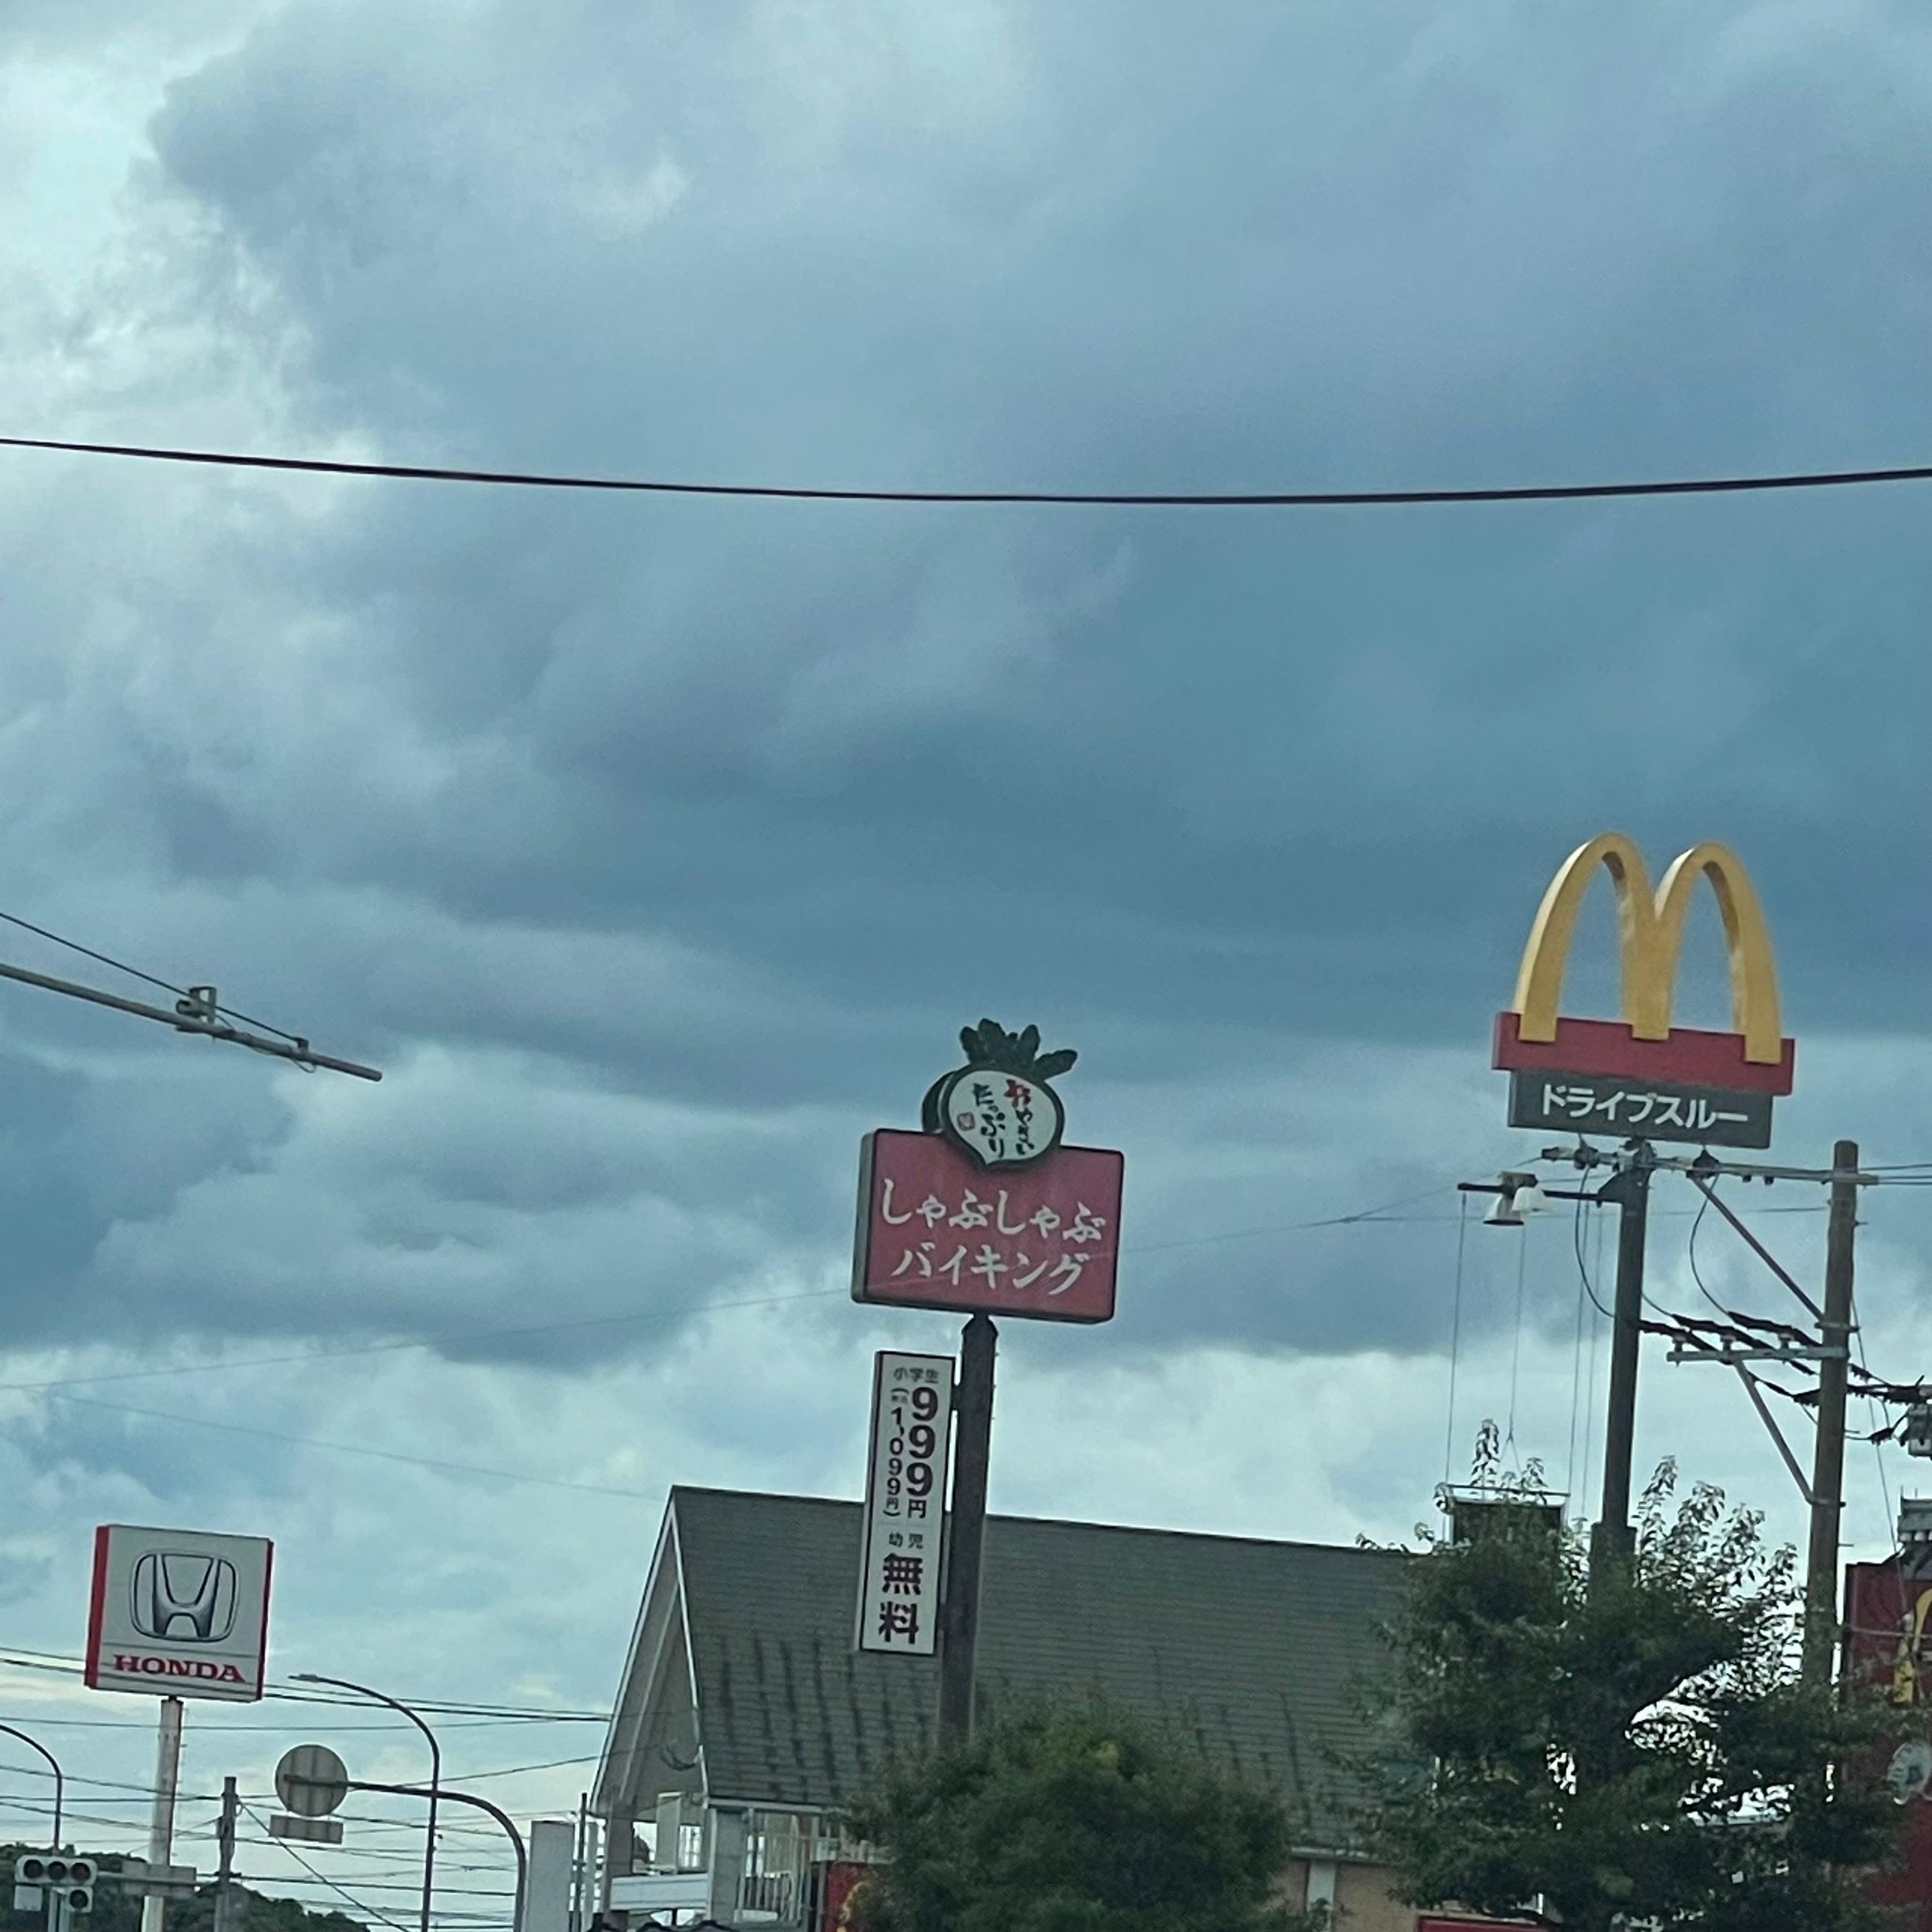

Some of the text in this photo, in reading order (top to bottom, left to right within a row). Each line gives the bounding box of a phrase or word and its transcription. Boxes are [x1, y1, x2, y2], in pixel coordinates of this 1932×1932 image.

[973, 1083, 1006, 1158] たっぷり
[1542, 1084, 1749, 1129] ドライブスルー
[882, 1178, 1107, 1244] しゃぶしゃぶ
[891, 1242, 1090, 1296] バイキング
[894, 1367, 939, 1384] 小学生
[906, 1386, 939, 1519] 999円
[889, 1532, 924, 1549] 幼児
[878, 1553, 924, 1644] 無料
[113, 1654, 246, 1683] HONDA
